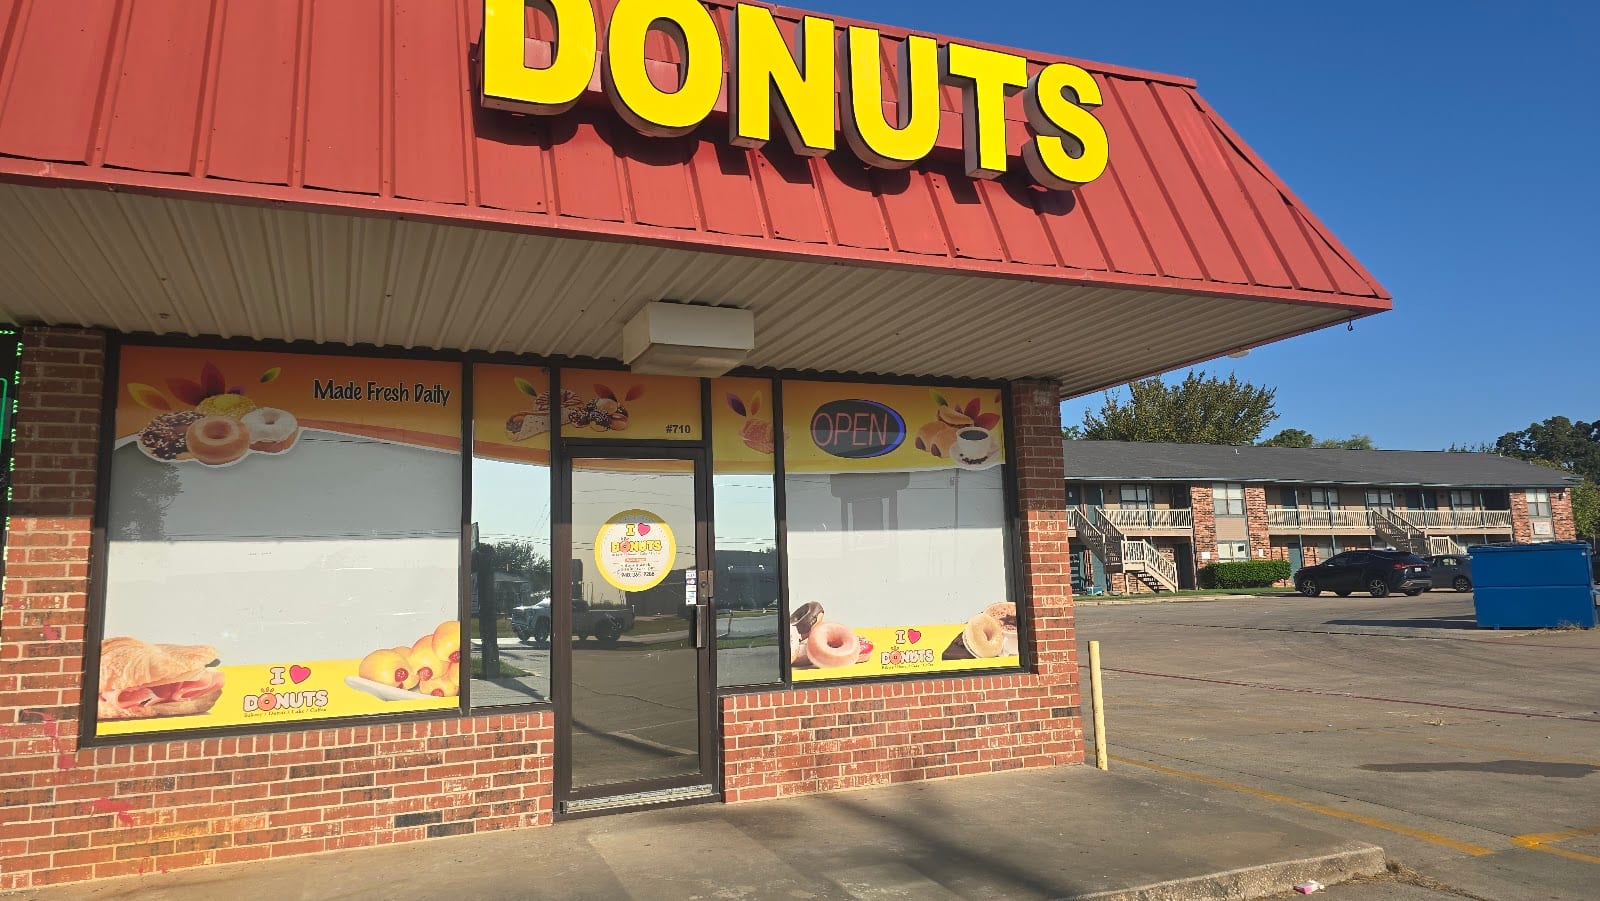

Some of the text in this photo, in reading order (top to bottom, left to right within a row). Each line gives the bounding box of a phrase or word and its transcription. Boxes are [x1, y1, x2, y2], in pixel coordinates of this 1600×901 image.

[483, 0, 1109, 187] DONUTS
[314, 379, 450, 406] Made Fresh Daily
[665, 424, 691, 434] #710
[812, 412, 888, 446] OPEN
[626, 523, 635, 536] I
[611, 539, 662, 553] DONUTS
[895, 629, 906, 644] I
[881, 648, 934, 665] DONUTS
[269, 666, 285, 685] I
[243, 689, 328, 712] DONUTS
